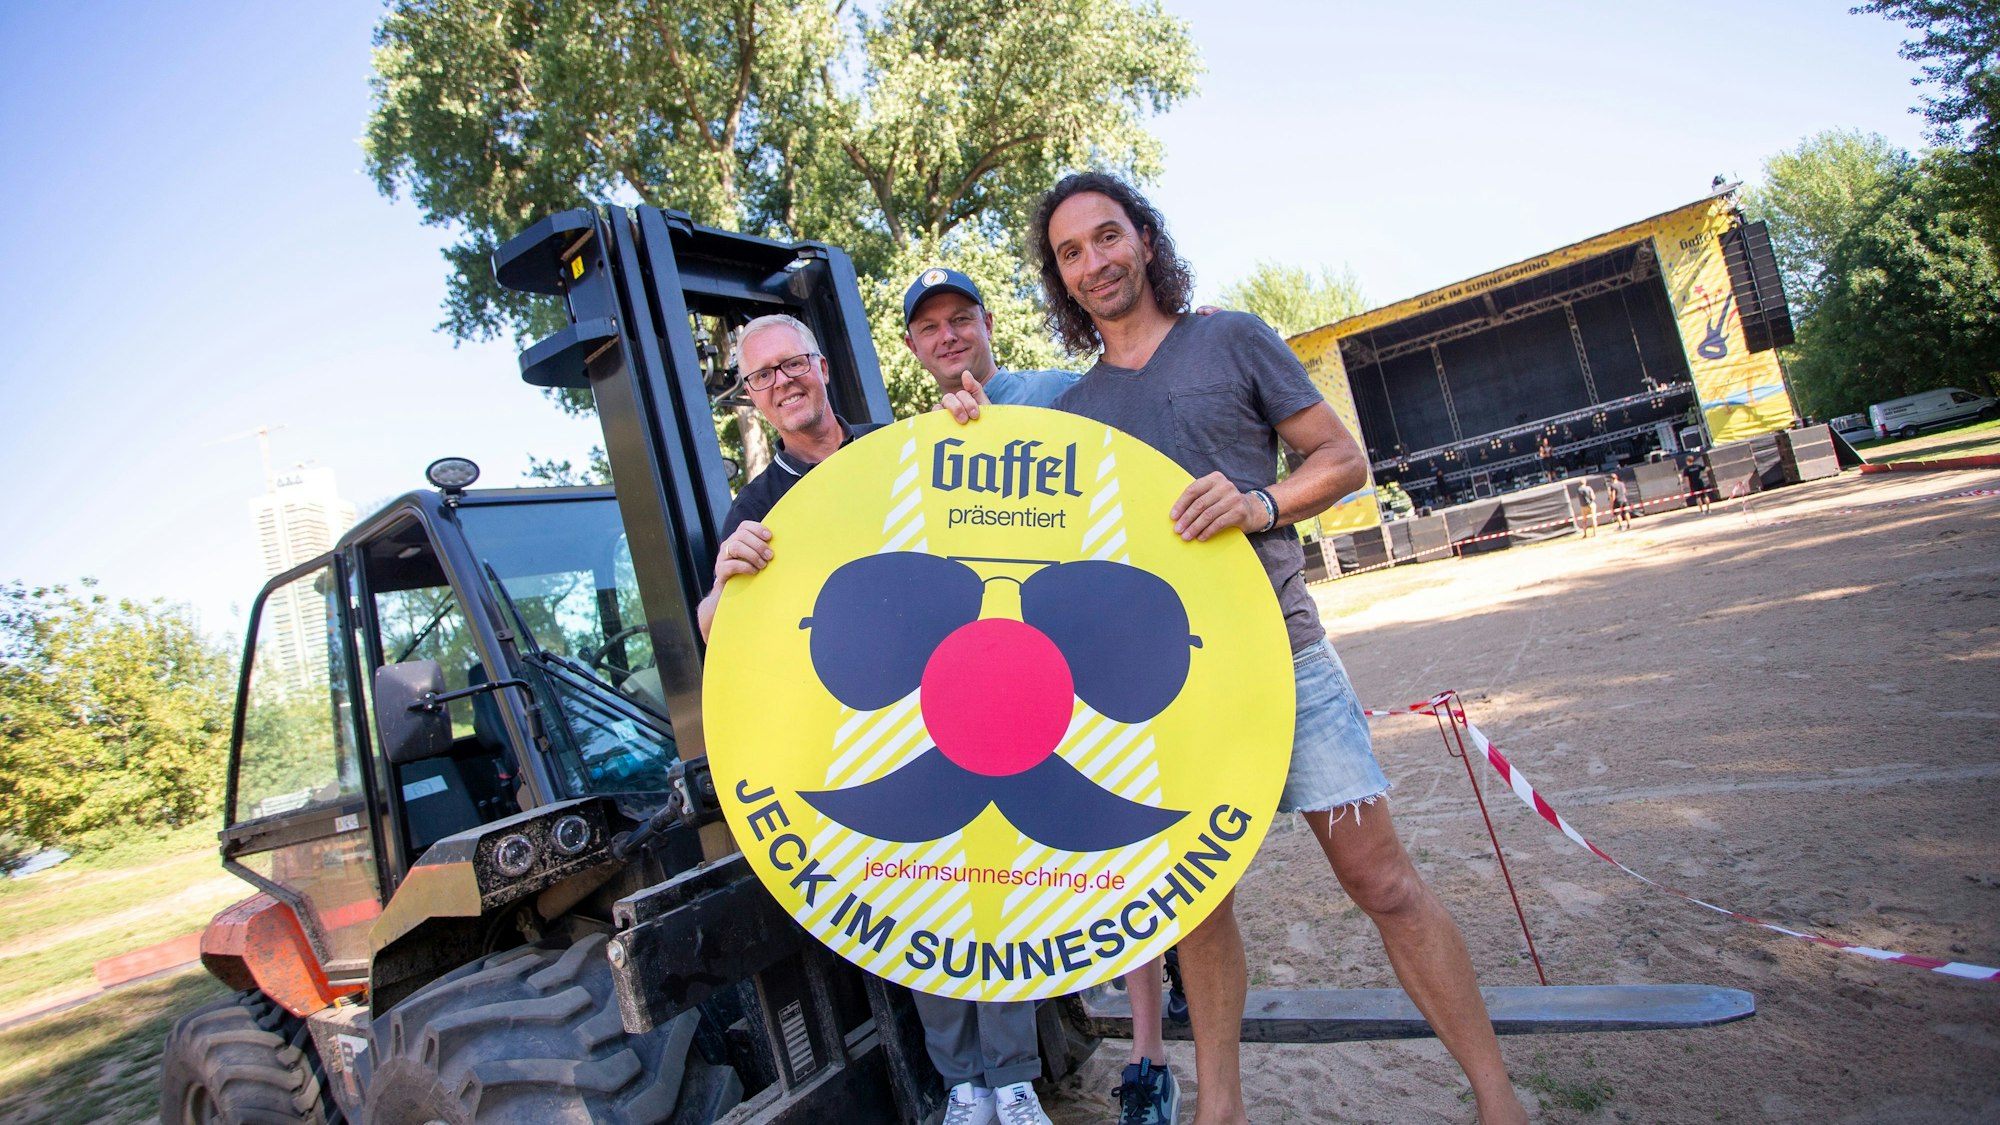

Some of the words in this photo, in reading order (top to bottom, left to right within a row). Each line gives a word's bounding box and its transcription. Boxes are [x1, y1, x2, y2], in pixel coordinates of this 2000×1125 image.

[1418, 294, 1446, 309] JECK
[1449, 289, 1462, 298] IM
[1466, 259, 1549, 292] SUNNESCHING
[932, 437, 1083, 500] Gaffel
[948, 505, 1066, 528] präsentiert
[735, 779, 837, 908] JECK
[830, 892, 897, 953] IM
[904, 804, 1253, 981] SUNNESCHING
[863, 857, 1126, 894] jeckimsunnesching.de
